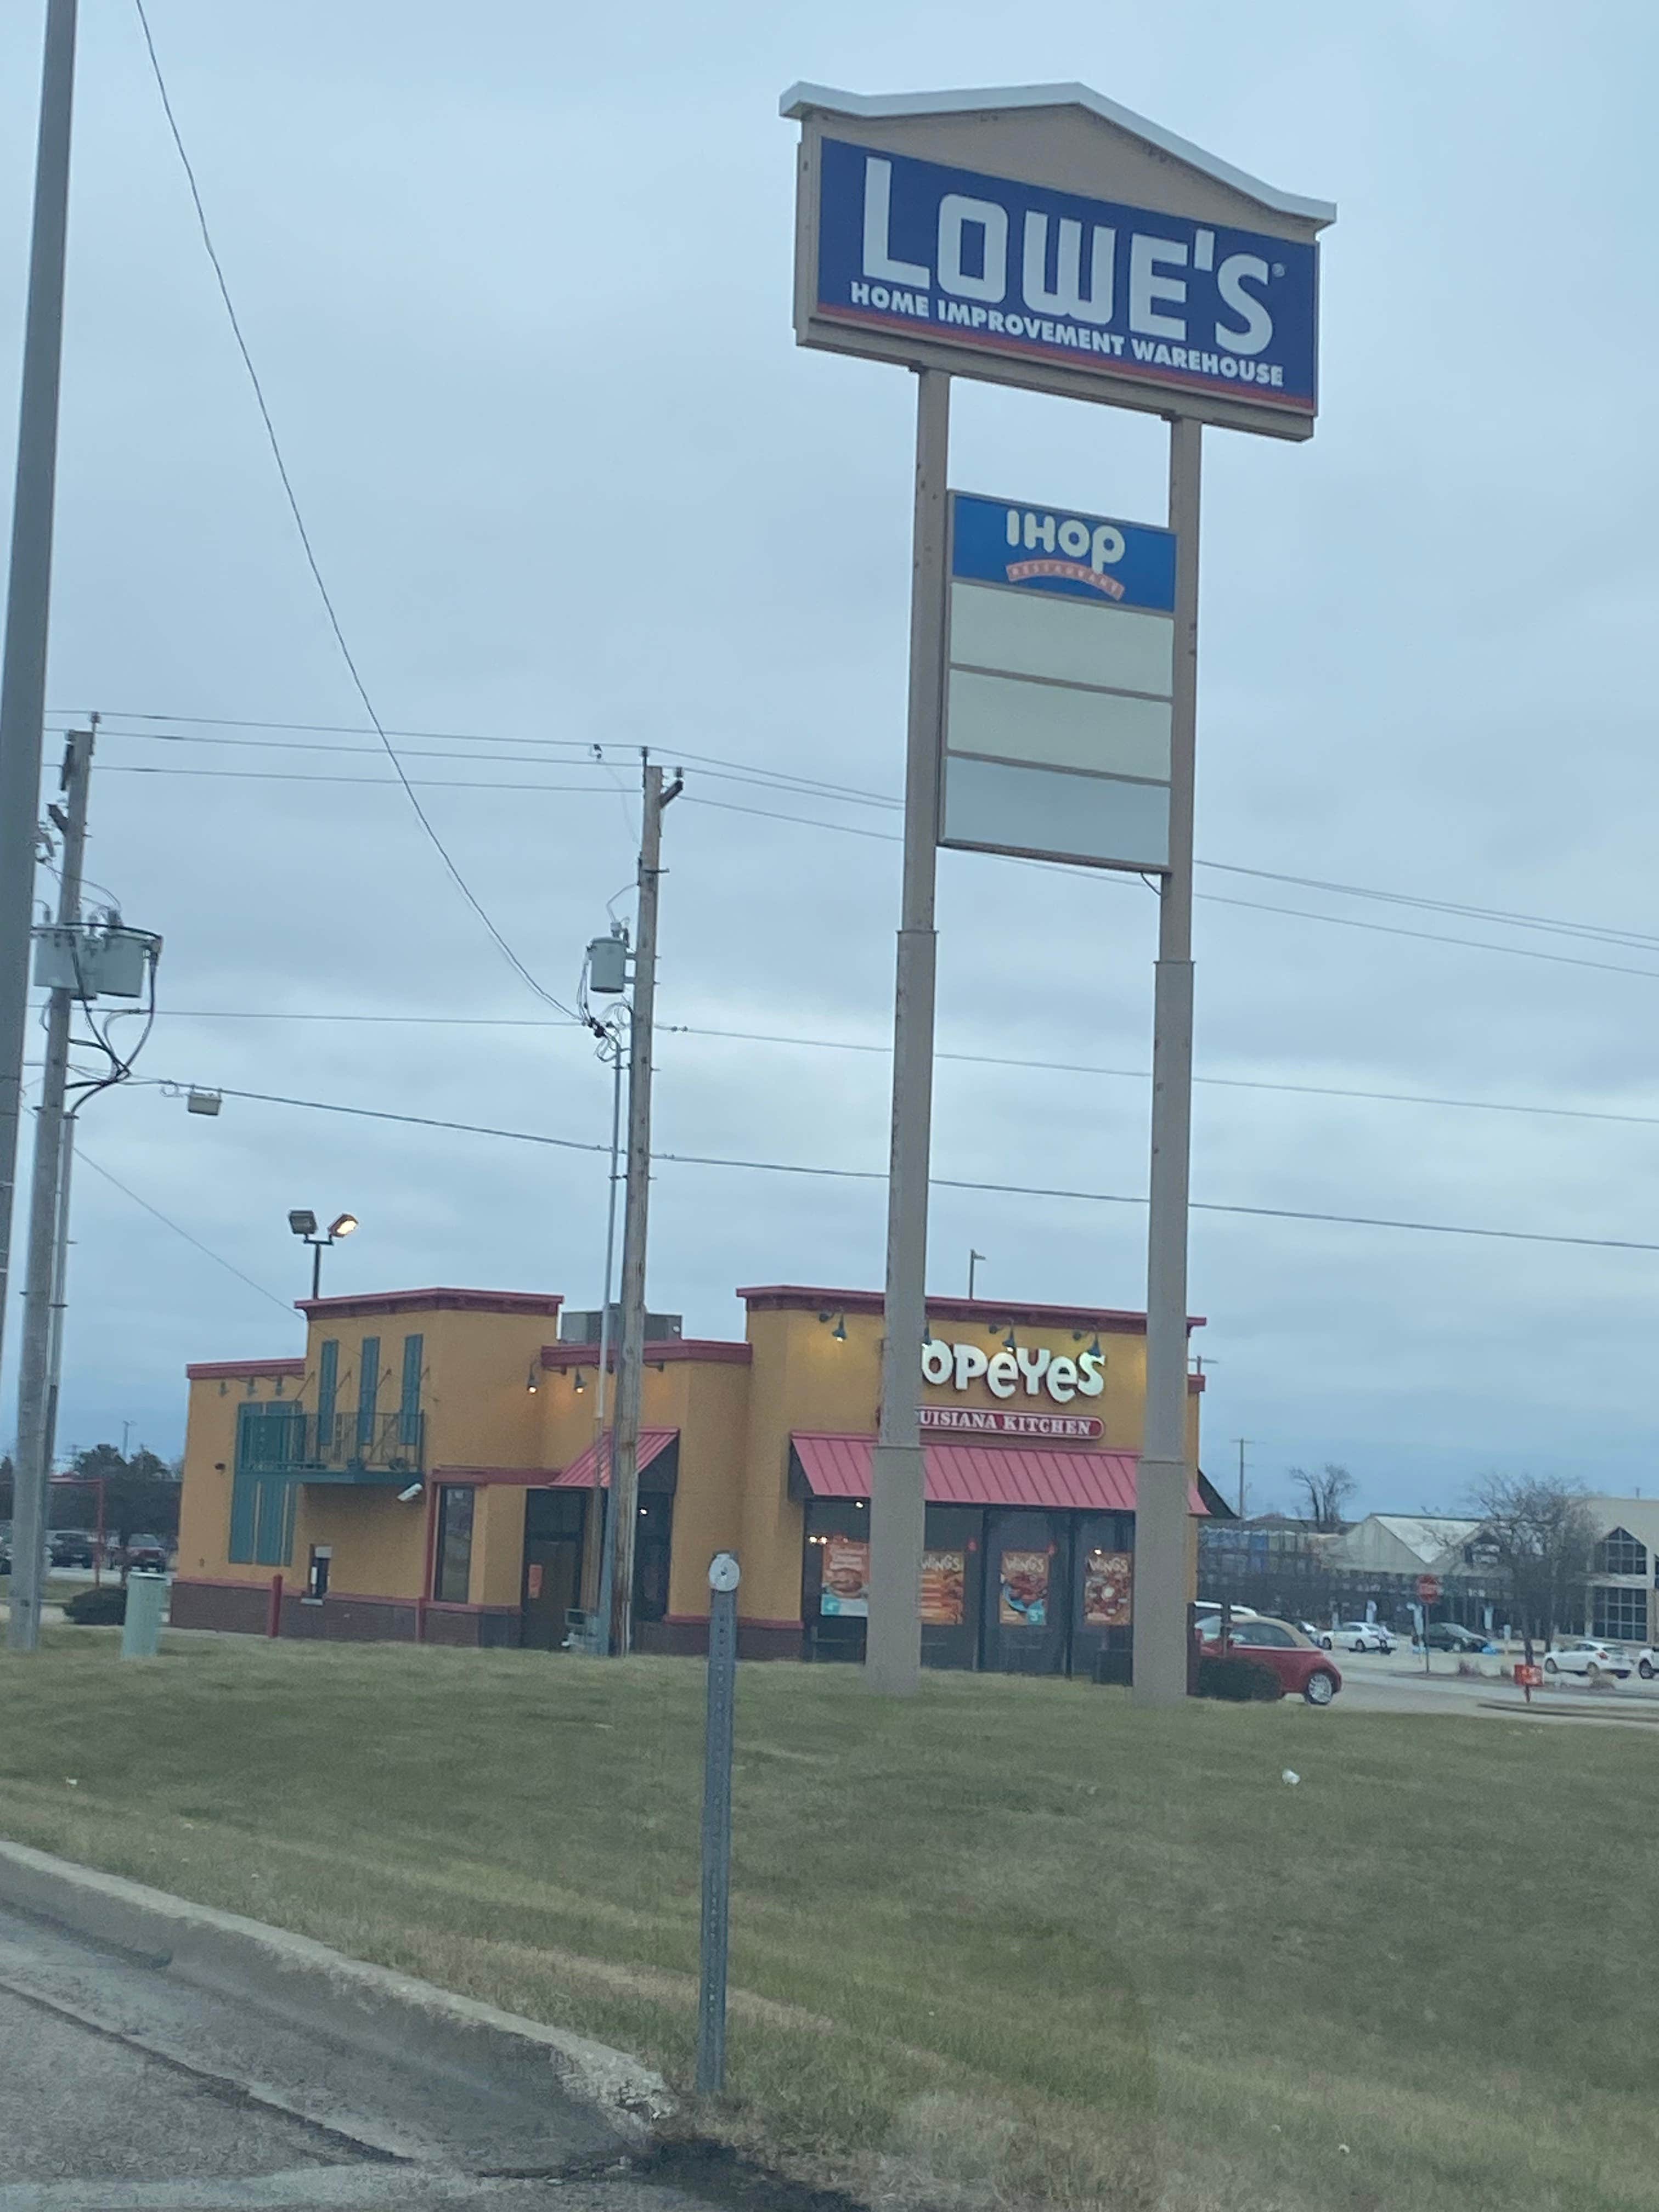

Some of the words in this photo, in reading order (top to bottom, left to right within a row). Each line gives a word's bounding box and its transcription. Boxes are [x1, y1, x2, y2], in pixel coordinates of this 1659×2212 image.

[863, 156, 1273, 356] LOWE'S
[850, 280, 930, 318] HOME
[938, 298, 1125, 357] IMPROVEMENT
[1131, 337, 1284, 388] WAREHOUSE
[1006, 509, 1125, 574] IHOP
[919, 1410, 997, 1429] UISIANA
[1002, 1414, 1092, 1436] KITCHEN
[1004, 1555, 1045, 1573] WINGS
[1087, 1557, 1128, 1573] WINGS
